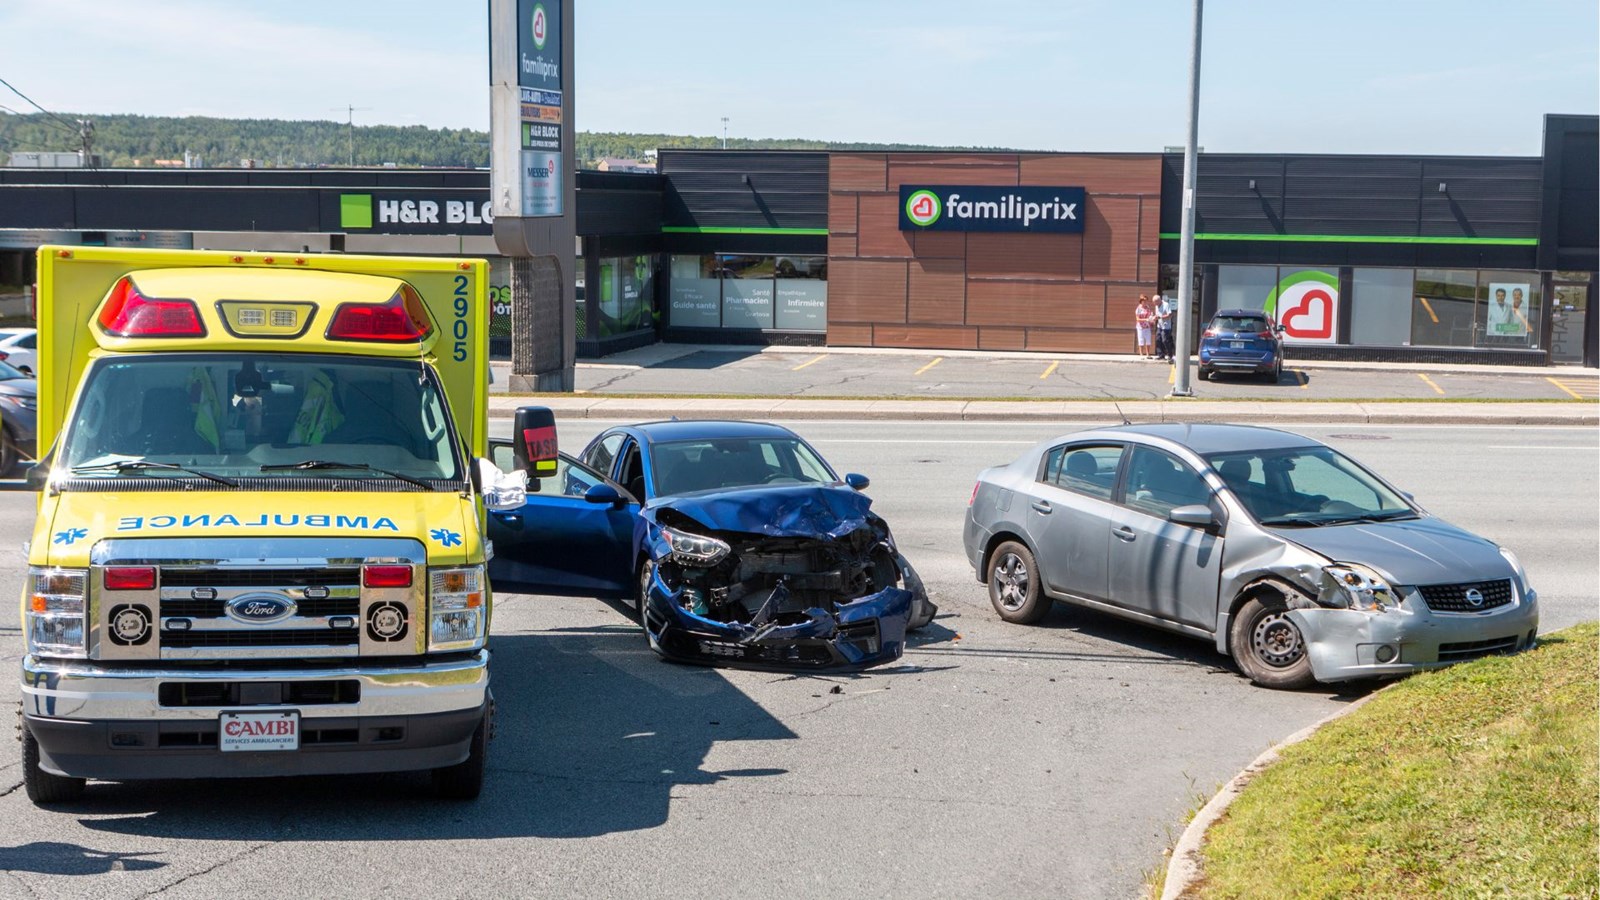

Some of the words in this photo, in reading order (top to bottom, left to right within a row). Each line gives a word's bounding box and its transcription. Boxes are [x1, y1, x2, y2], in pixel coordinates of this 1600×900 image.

[522, 53, 558, 81] familiprix
[530, 125, 541, 136] H&R
[542, 126, 558, 138] BLOCK
[527, 167, 549, 178] MESSER
[379, 200, 439, 223] H&R
[446, 200, 495, 224] BLO
[946, 194, 1077, 227] familiprix
[490, 286, 511, 303] OS
[726, 296, 769, 304] Pharmacien
[673, 301, 694, 309] Guide
[696, 301, 717, 309] santé
[787, 299, 825, 307] Infirmière
[453, 275, 468, 362] 2905
[244, 601, 276, 615] Ford
[225, 720, 295, 737] CAMBI
